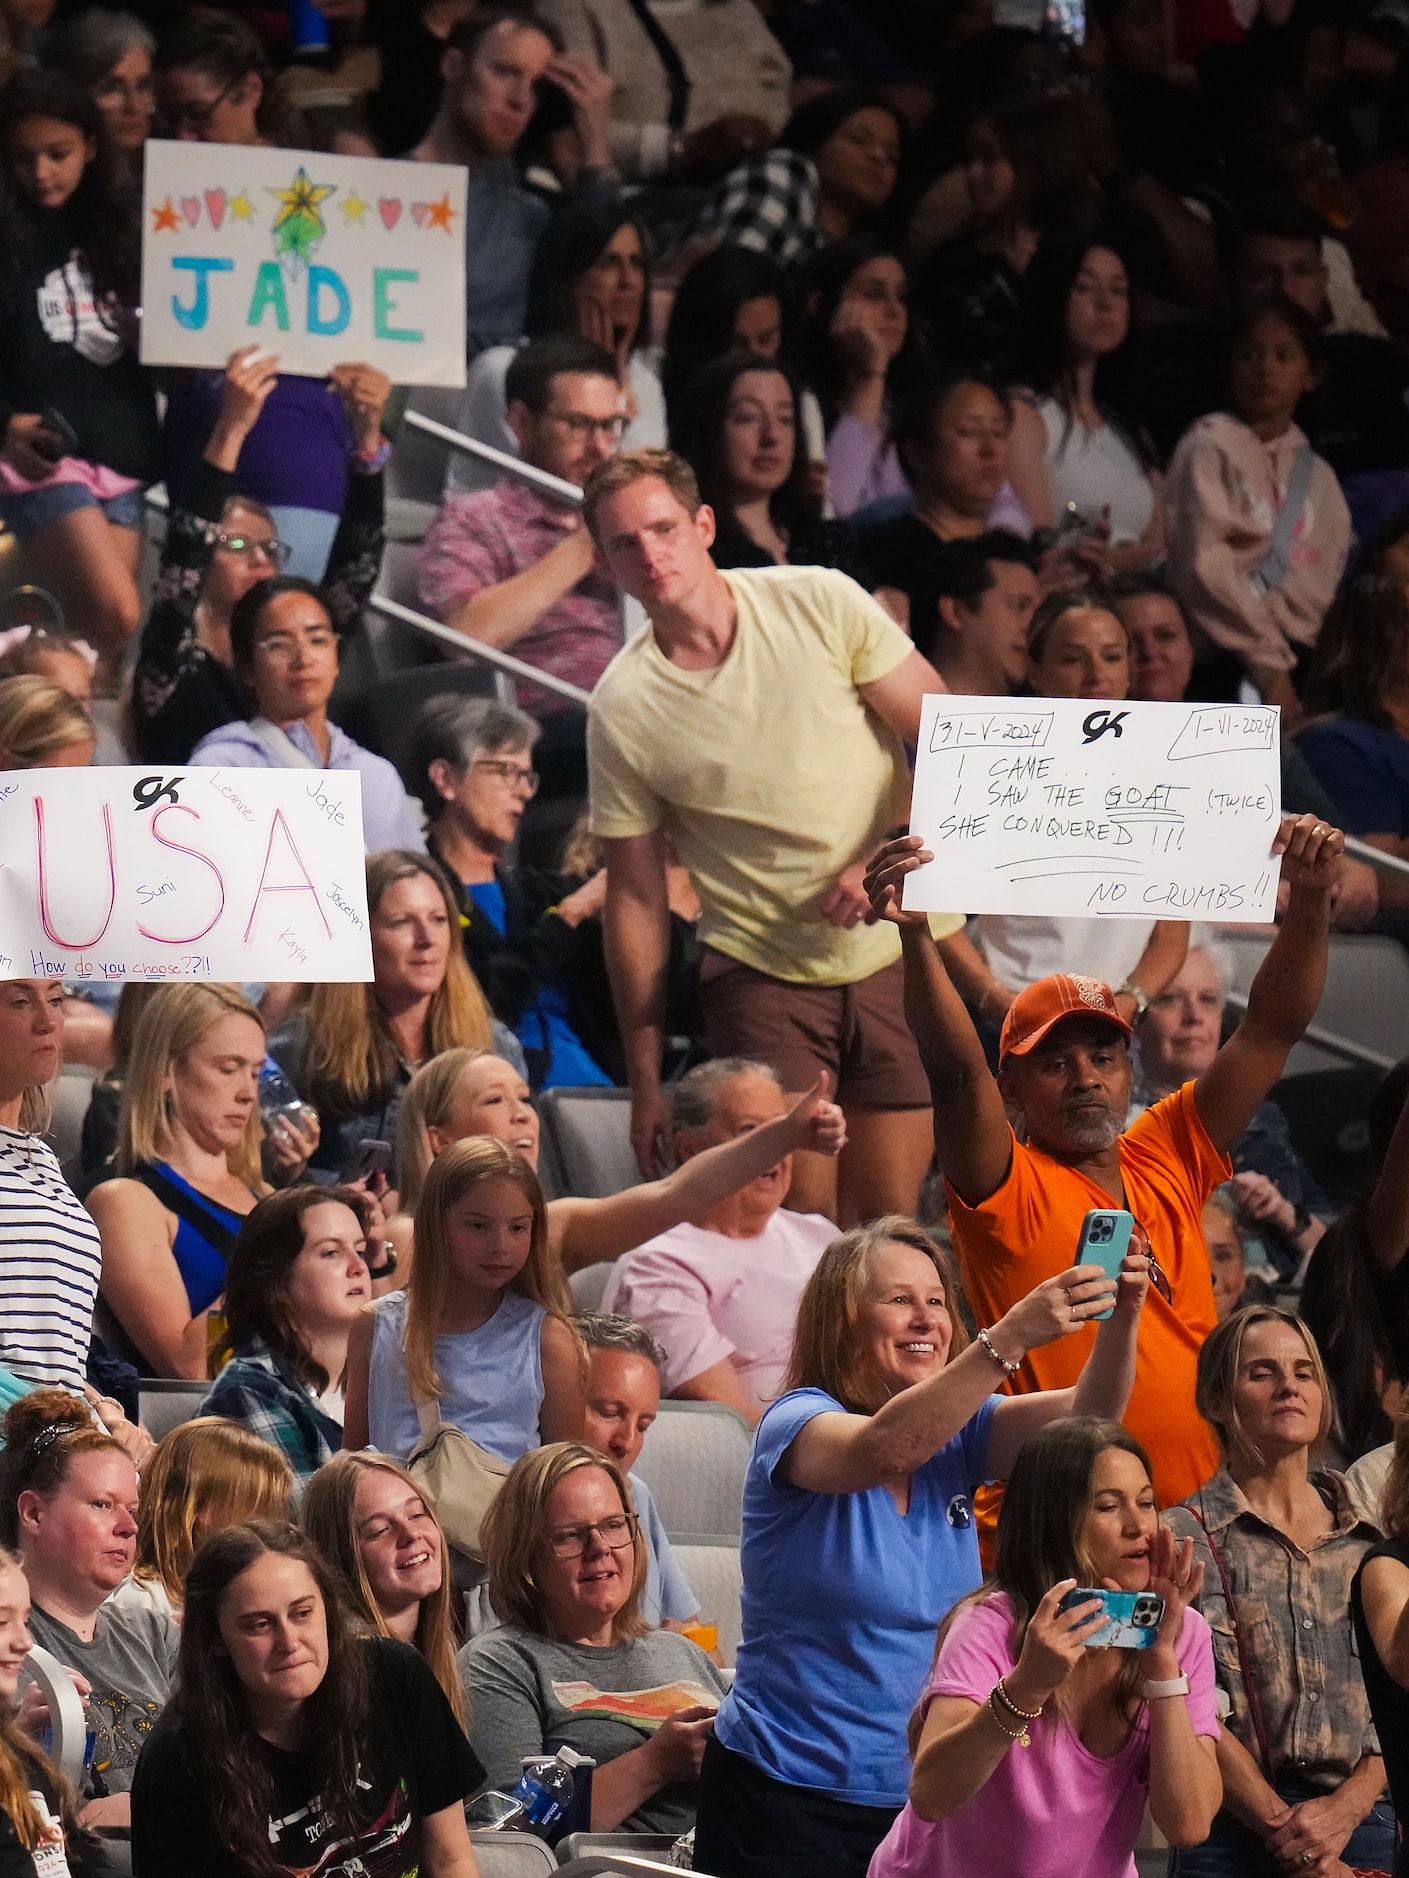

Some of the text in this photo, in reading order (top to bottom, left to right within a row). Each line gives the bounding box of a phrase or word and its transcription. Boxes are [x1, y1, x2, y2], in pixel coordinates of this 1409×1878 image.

[172, 256, 424, 343] JADE
[939, 715, 1044, 747] 31-V-2024
[988, 755, 1056, 780] CAME
[209, 771, 255, 822] Leanne
[306, 780, 345, 826] Jade
[987, 780, 1029, 808] SAW
[1044, 783, 1085, 807] THE
[1105, 784, 1191, 811] GOAT
[1207, 784, 1274, 823] (TWICE)
[939, 814, 990, 840] SHE
[1003, 813, 1133, 845] CONQUERED
[32, 795, 334, 951] USA
[136, 876, 177, 905] Suni
[326, 881, 365, 931] Joscelyn
[1087, 881, 1127, 907] NO
[31, 950, 66, 978] How
[74, 956, 93, 973] do
[98, 963, 126, 978] you
[277, 926, 308, 964] Kayla
